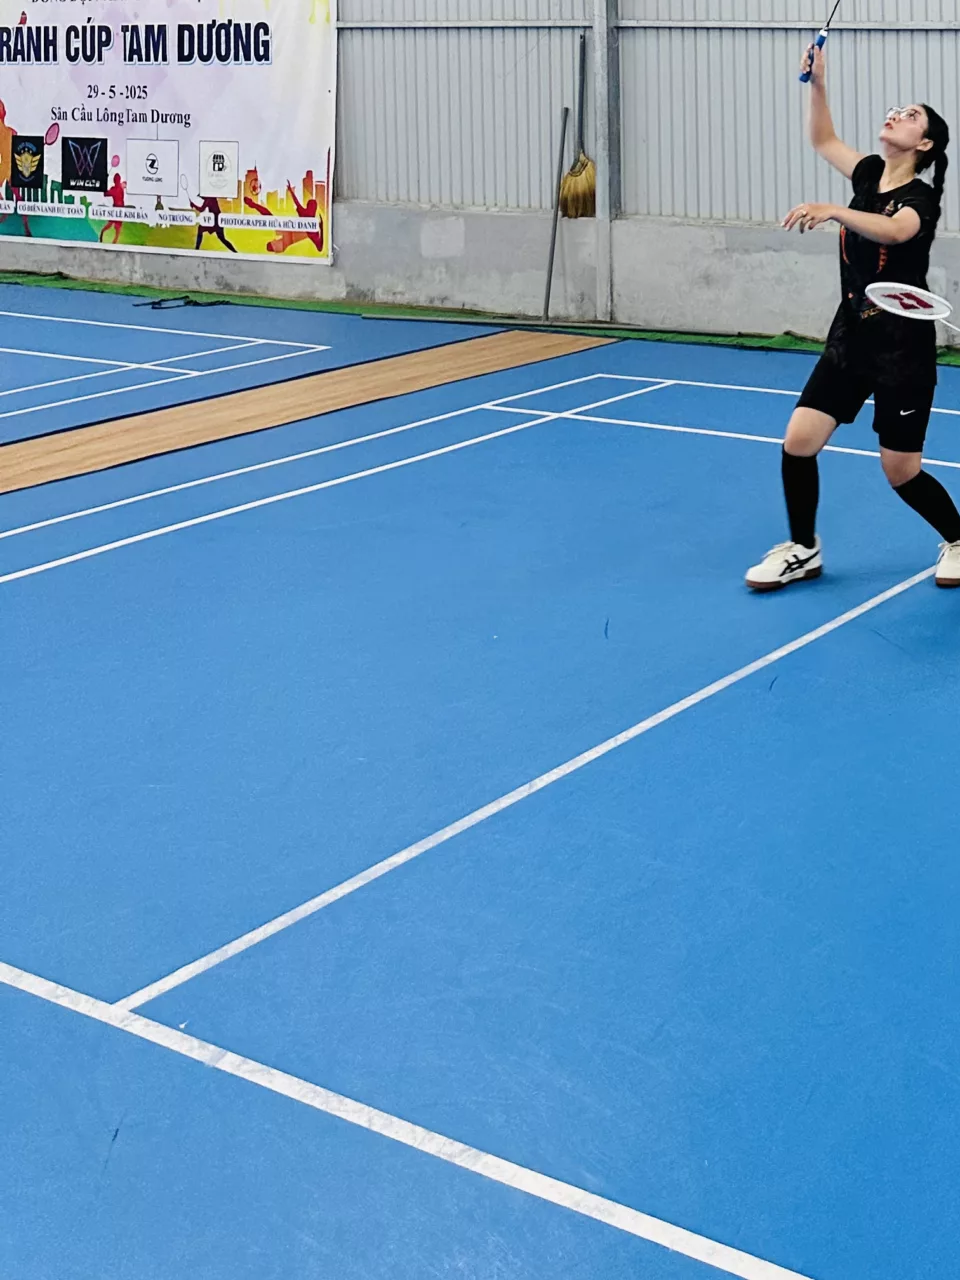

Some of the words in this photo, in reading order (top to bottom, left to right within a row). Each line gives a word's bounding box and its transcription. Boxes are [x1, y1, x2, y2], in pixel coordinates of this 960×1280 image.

[66, 17, 112, 63] CÚP
[121, 24, 168, 63] TAM
[177, 19, 270, 63] DƯƠNG
[50, 106, 68, 121] Sân
[71, 103, 93, 122] Cầu
[96, 107, 124, 126] Lông
[125, 108, 148, 124] Tam
[150, 109, 191, 128] Dương
